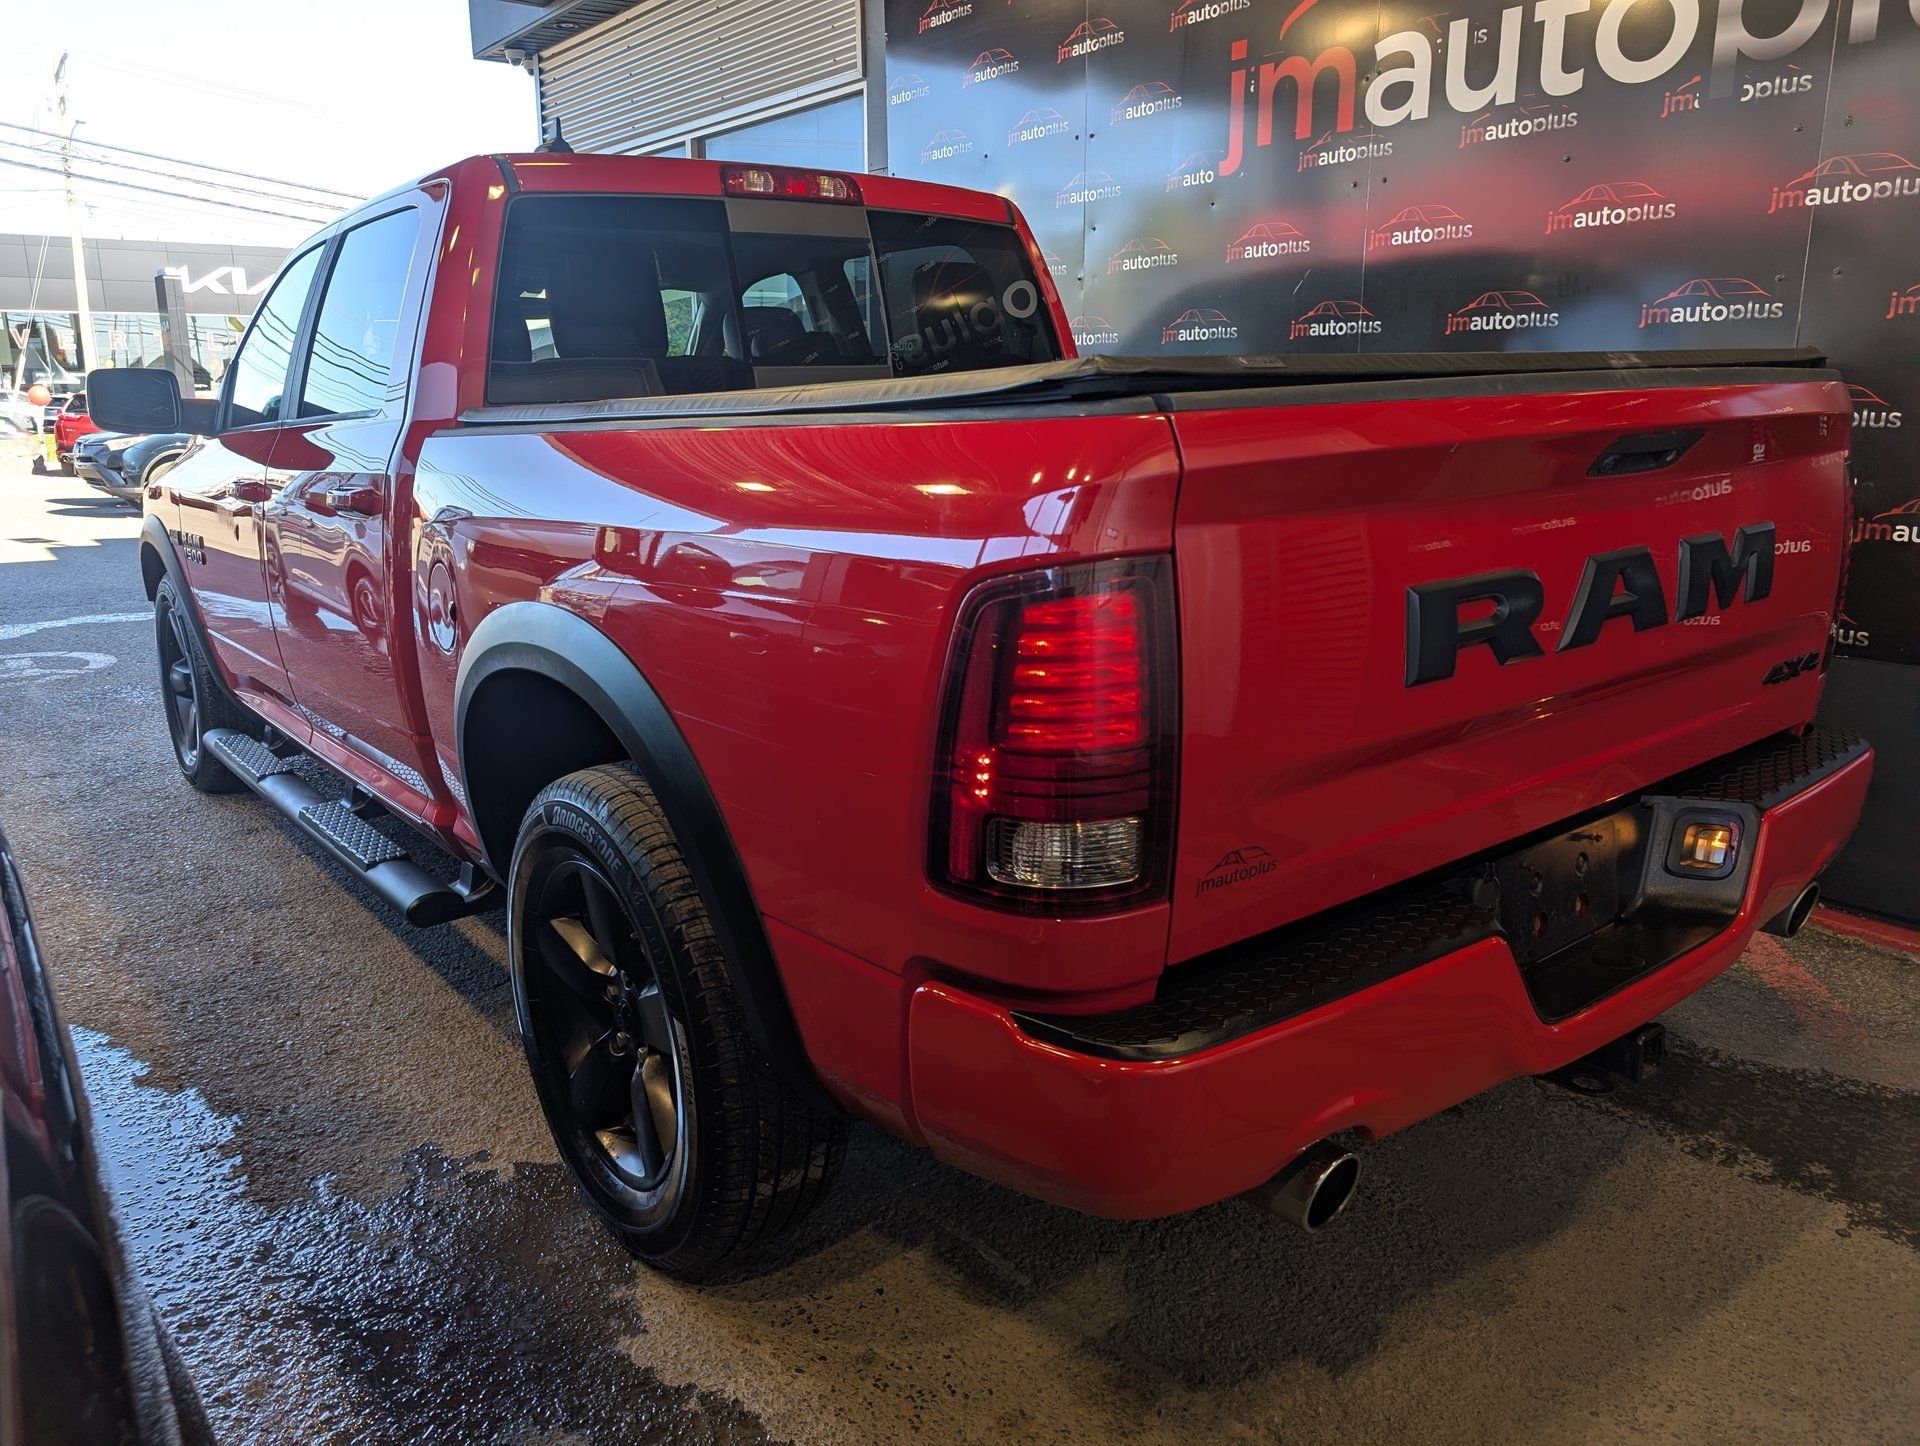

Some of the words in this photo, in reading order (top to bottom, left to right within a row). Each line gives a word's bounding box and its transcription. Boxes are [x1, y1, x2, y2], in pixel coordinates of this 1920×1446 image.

[918, 3, 972, 34] jmautoplus
[1057, 31, 1125, 63] jmautoplus
[962, 59, 1019, 89] jmautoplus
[1109, 96, 1182, 126] jmautoplus
[1008, 120, 1069, 147] jmautoplus
[1459, 111, 1578, 149] jmautoplus
[920, 141, 973, 166] jmautoplus
[1297, 141, 1393, 173] jmautoplus
[1056, 184, 1122, 208] jmautoplus
[1545, 202, 1677, 235] jmautoplus
[1225, 239, 1311, 263] jmautoplus
[1368, 223, 1473, 251] jmautoplus
[1107, 252, 1178, 275] jmautoplus
[1445, 310, 1559, 335] jmautoplus
[1638, 301, 1783, 328] jmautoplus
[1072, 331, 1119, 346] utoplus
[1161, 326, 1238, 345] jmautoplus
[1289, 319, 1382, 340] jmautoplus
[1404, 521, 1776, 688] RAM
[552, 805, 622, 871] BRIDGESTONE
[1195, 859, 1278, 898] jmautoplus
